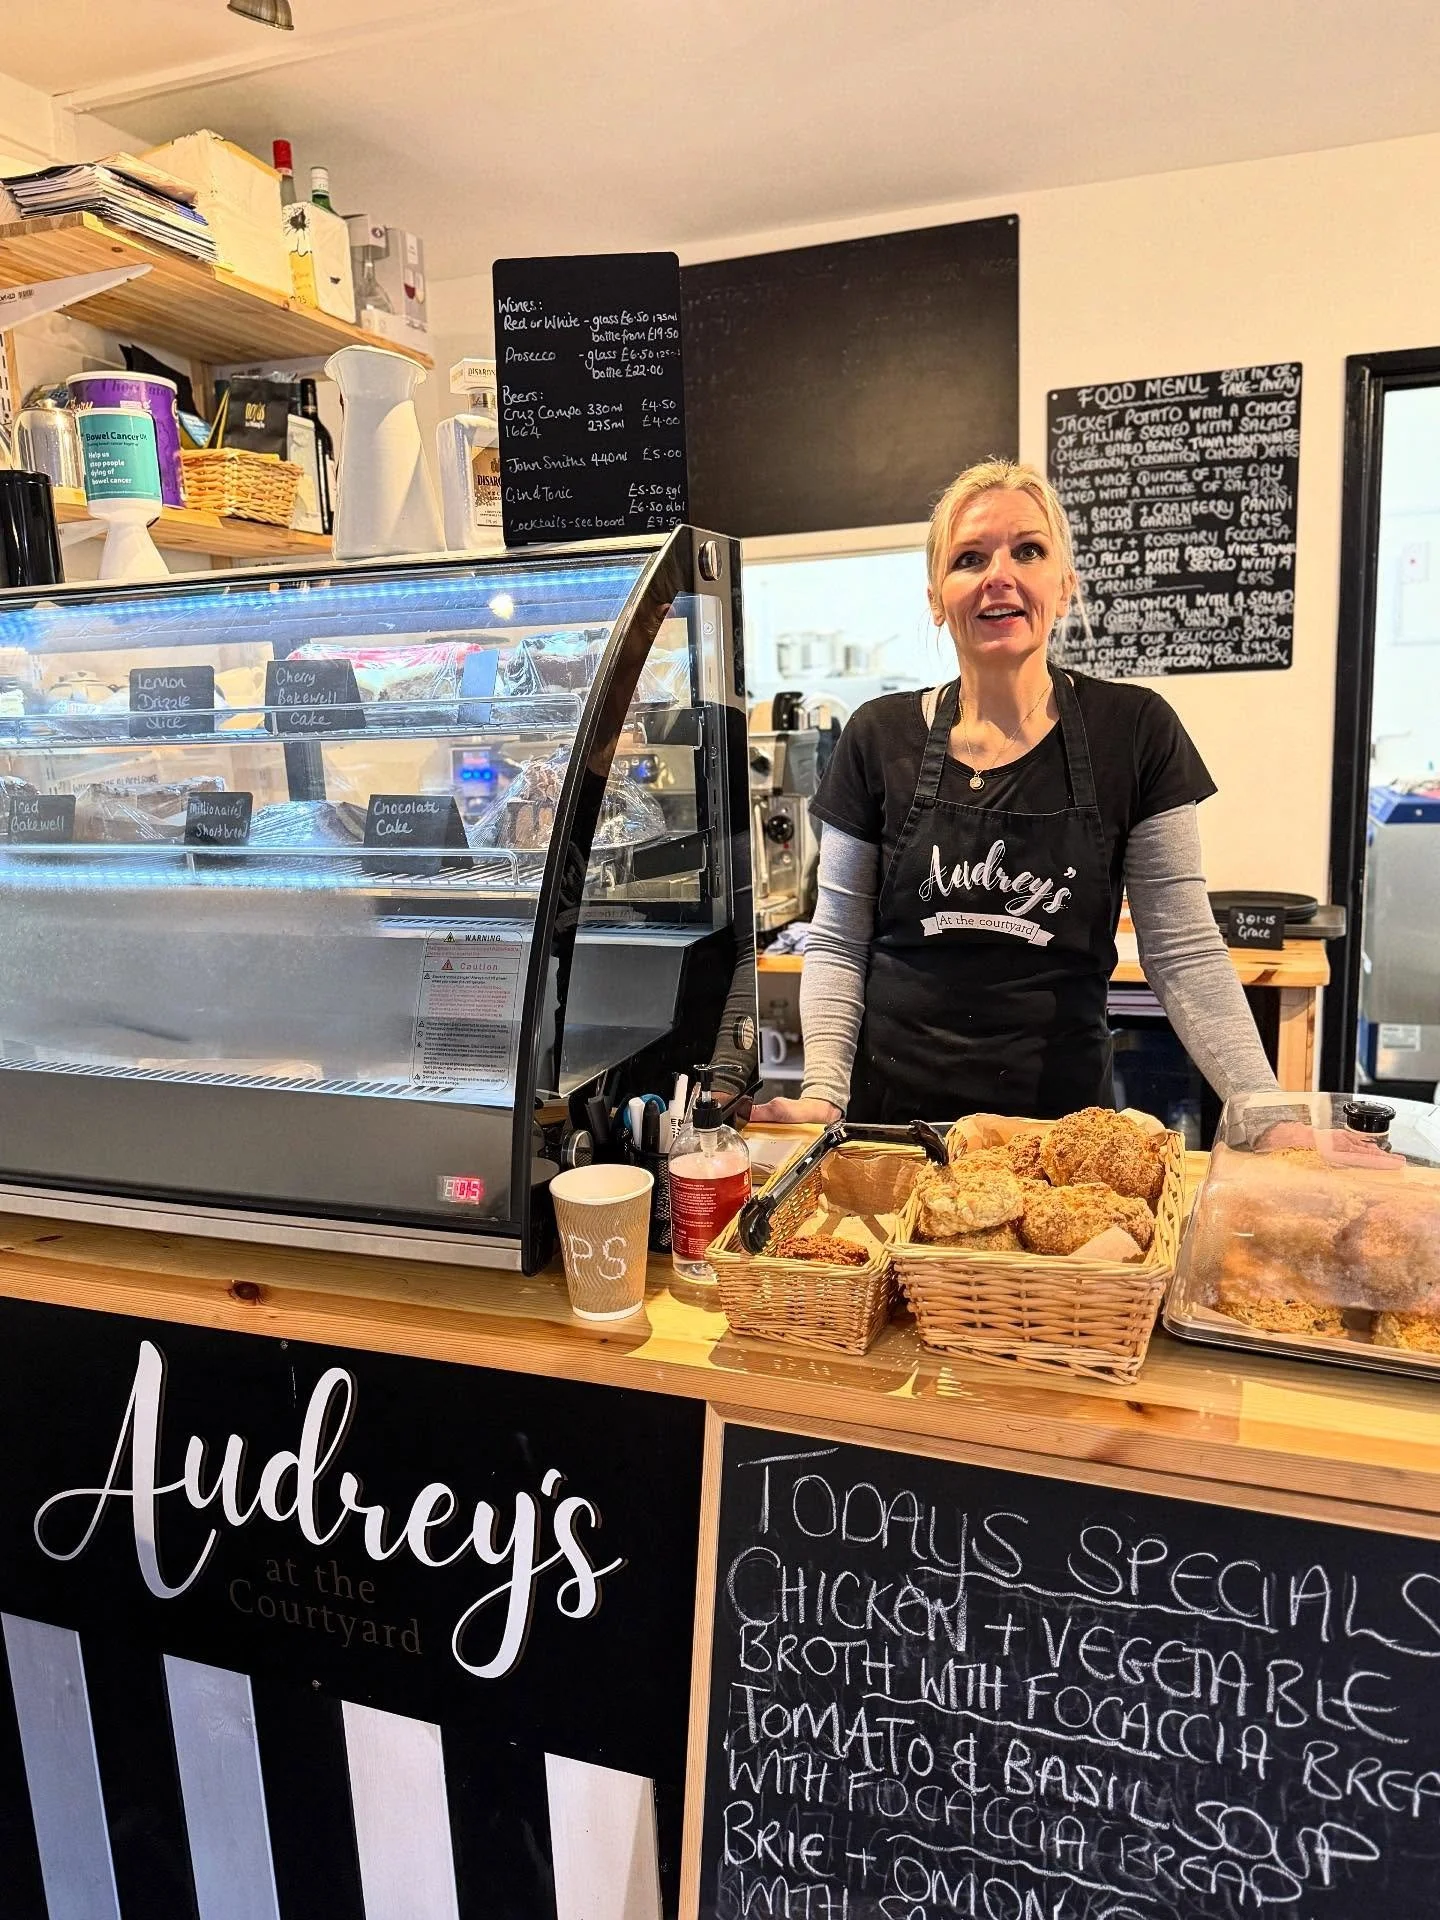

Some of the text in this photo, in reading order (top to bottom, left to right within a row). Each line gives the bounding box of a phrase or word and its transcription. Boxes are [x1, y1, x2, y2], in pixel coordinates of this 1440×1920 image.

[499, 297, 543, 313] Wines:
[504, 310, 678, 331] Red or White glass £6.50 175ml
[592, 327, 679, 344] bottle from £19.50
[505, 347, 654, 370] Prosecco glass £6.50
[592, 365, 664, 380] bottle £22.00
[1221, 367, 1269, 381] EAT IN
[502, 385, 544, 406] Beers:
[1077, 376, 1209, 409] FOOD MENU
[503, 398, 676, 427] Cruz Campo 330ml £4.50
[1051, 400, 1297, 434] JACKET POTATO WITH A CHOICE
[85, 432, 139, 442] Bowel Cancer
[506, 415, 681, 439] 1664 275ml £4.00
[1058, 414, 1292, 449] OF FILLING SERVED WITH SALAD
[1188, 435, 1224, 449] TUNA
[102, 460, 125, 468] people
[506, 447, 682, 474] John Smiths 440ml £5.00
[1094, 472, 1132, 486] MADE
[1137, 469, 1188, 486] QUICHE
[1192, 467, 1209, 481] OF
[1213, 466, 1243, 479] THE
[1247, 463, 1284, 480] DAY
[505, 486, 529, 504] Gin
[542, 486, 573, 502] Tonic
[628, 482, 664, 497] £5.50
[666, 484, 681, 500] sgl
[1099, 487, 1128, 500] WITH
[1131, 486, 1140, 497] A
[1145, 482, 1196, 497] MIXTURE
[1202, 481, 1221, 493] OF
[629, 499, 685, 514] £6.50 dbl
[1091, 506, 1132, 521] BACON
[1140, 505, 1149, 516] +
[1153, 499, 1234, 520] CRANBERRY
[1240, 495, 1292, 511] PANINI
[595, 516, 625, 527] board
[1091, 518, 1133, 534] SALAD
[1140, 511, 1191, 527] GARNISH
[1128, 538, 1138, 548] +
[1144, 530, 1218, 546] ROSEMARY
[1100, 550, 1140, 566] FILLED
[1145, 547, 1179, 561] WITH
[1227, 542, 1261, 557] VINE
[1144, 561, 1181, 575] BASIL
[1241, 556, 1277, 571] WITH
[1280, 555, 1291, 570] A
[1095, 577, 1156, 594] GARNISH
[1111, 593, 1187, 613] SANDWICH
[1195, 592, 1229, 607] WITH
[1234, 591, 1245, 606] A
[1247, 590, 1294, 605] SALAD
[1121, 634, 1137, 646] OF
[1141, 633, 1166, 646] OUR
[1172, 627, 1241, 643] DELICIOUS
[1241, 626, 1292, 641] SALADS
[1146, 645, 1164, 657] OF
[137, 673, 186, 690] Lemon
[276, 667, 316, 686] Cherry
[137, 693, 191, 711] Drizzle
[277, 689, 337, 705] Bakewell
[373, 800, 440, 816] Chocolate
[10, 816, 65, 832] Bakewell
[376, 818, 413, 836] Cake
[918, 839, 1077, 917] Audrey's
[939, 914, 1036, 937] At the courtyard
[1238, 925, 1271, 940] Grace
[465, 934, 501, 942] WARNING
[460, 962, 498, 971] Caution
[33, 1340, 624, 1678] Audrey's
[737, 1447, 1029, 1611] TODAYS
[266, 1559, 375, 1604] at the
[229, 1578, 423, 1655] Courtyard
[727, 1546, 1409, 1744] CHICKEN + VEGETABLE
[739, 1621, 895, 1695] BROTH
[921, 1656, 1008, 1710] WITH
[1022, 1672, 1273, 1780] FOCACCIA
[731, 1682, 935, 1777] TOMATO
[1004, 1738, 1170, 1830] BASIL
[1172, 1800, 1380, 1886] SOUP
[729, 1749, 1301, 1908] WITH FOCACCIA BREAD
[724, 1800, 835, 1877] BRIE
[845, 1847, 877, 1888] +
